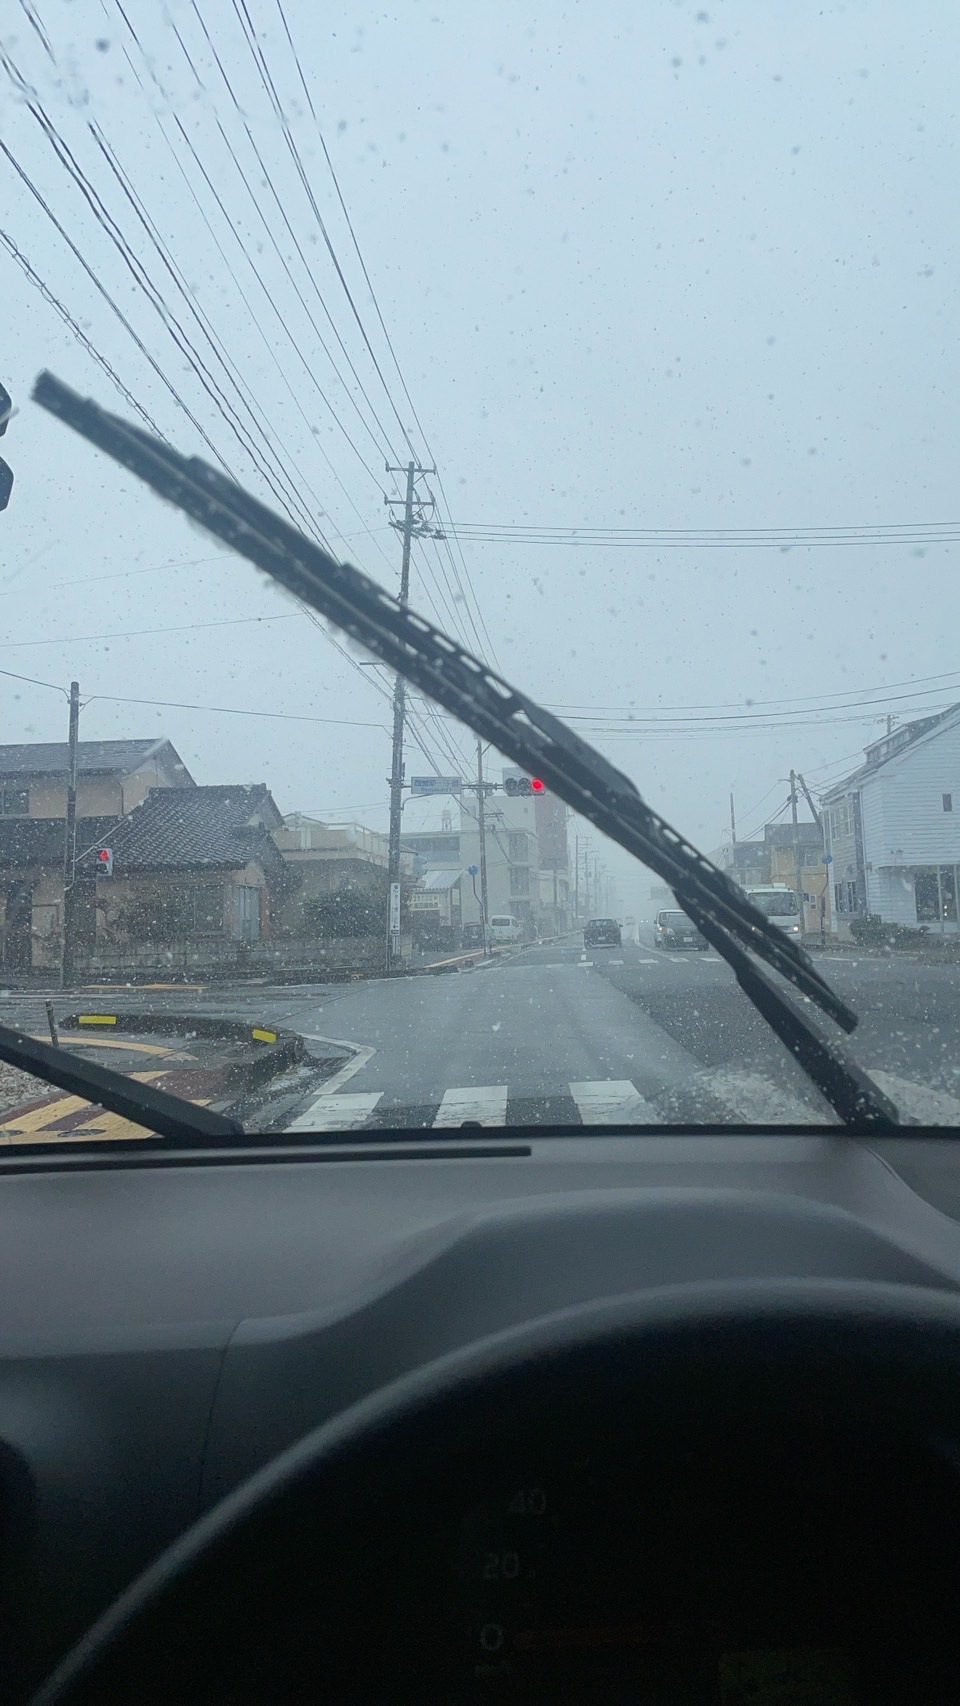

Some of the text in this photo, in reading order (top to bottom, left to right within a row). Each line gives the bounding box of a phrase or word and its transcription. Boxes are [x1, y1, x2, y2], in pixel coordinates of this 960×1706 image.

[508, 1488, 548, 1516] 40
[482, 1551, 521, 1580] 20
[480, 1623, 504, 1652] 0
